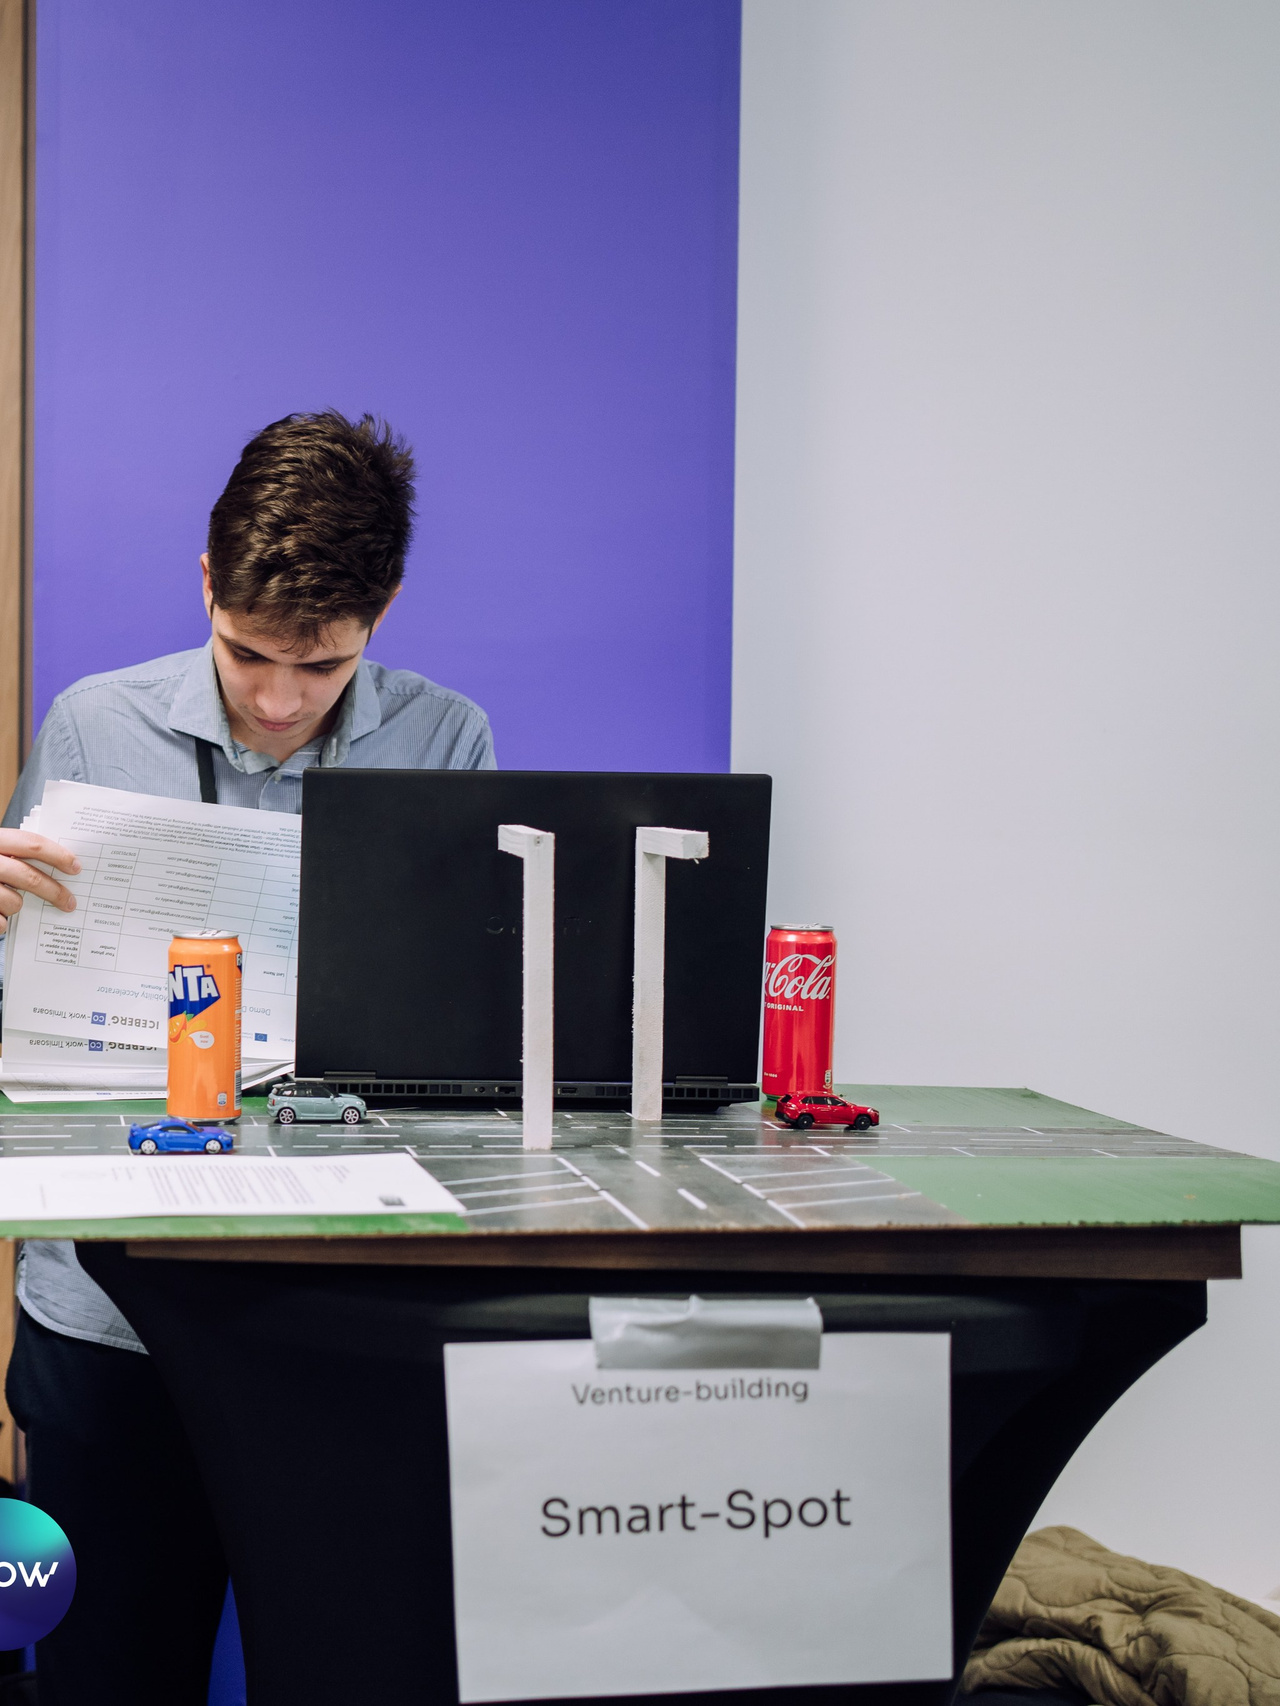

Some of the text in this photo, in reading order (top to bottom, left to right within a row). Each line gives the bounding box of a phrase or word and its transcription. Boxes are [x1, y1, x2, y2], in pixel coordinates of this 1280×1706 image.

[141, 983, 162, 991] Romania
[168, 966, 220, 1002] NTA
[97, 986, 140, 999] Accelerator
[32, 1007, 67, 1018] Timisoara
[248, 1006, 271, 1016] Demo
[766, 1002, 804, 1012] ORIGINAL
[111, 1015, 160, 1029] ICEBERG
[29, 1039, 64, 1048] Timisoara
[572, 1377, 809, 1405] Venture-building
[540, 1489, 851, 1538] Smart-Spot
